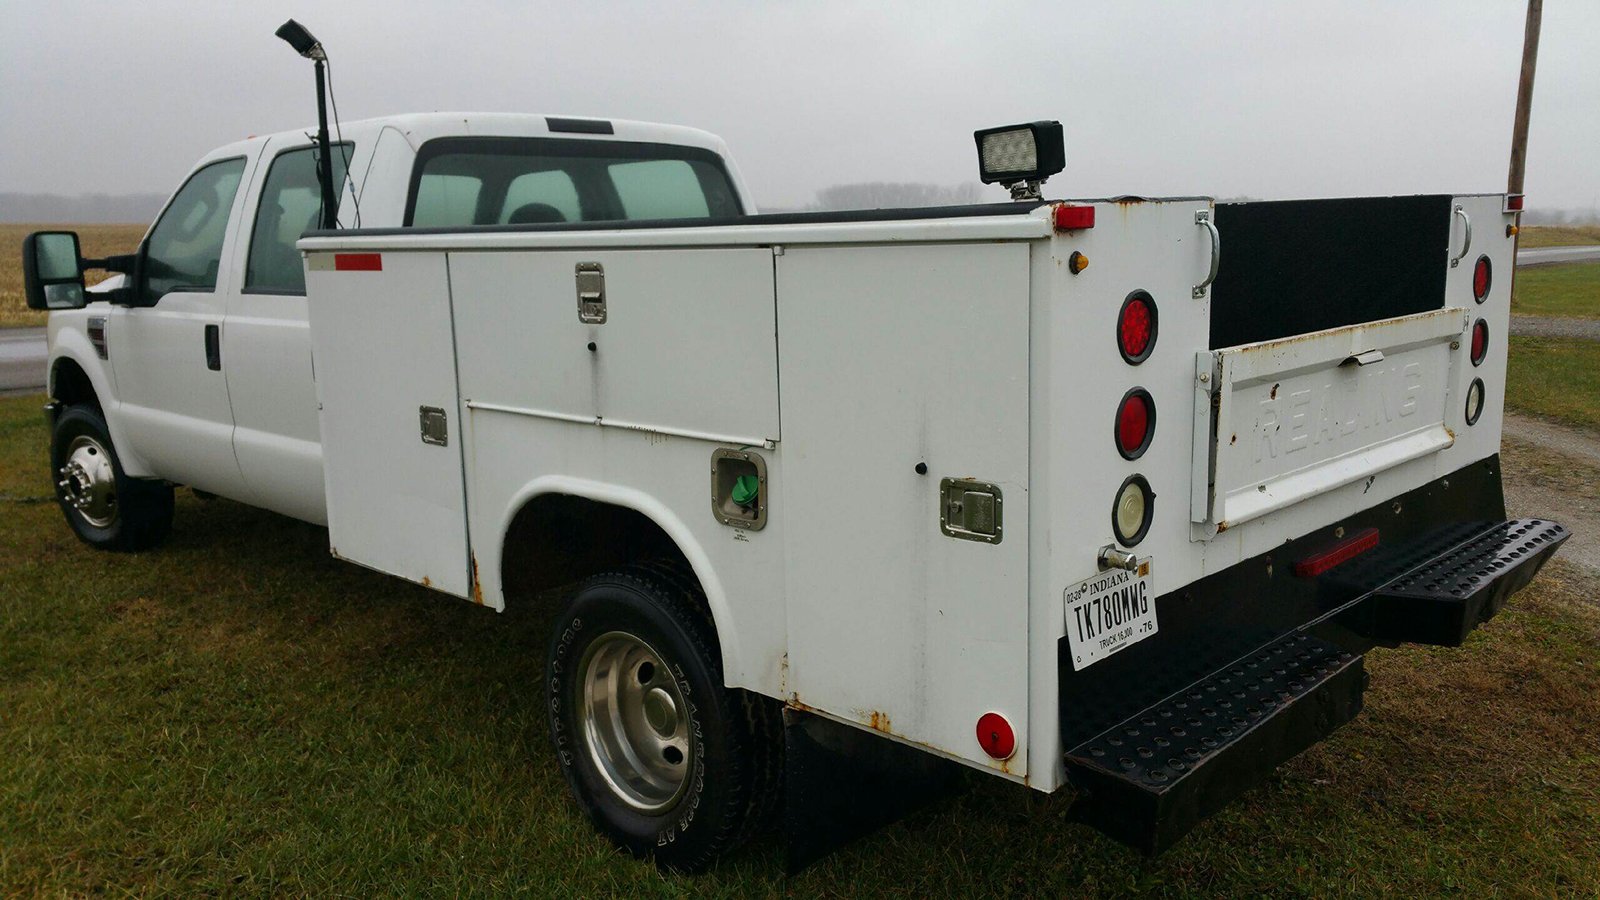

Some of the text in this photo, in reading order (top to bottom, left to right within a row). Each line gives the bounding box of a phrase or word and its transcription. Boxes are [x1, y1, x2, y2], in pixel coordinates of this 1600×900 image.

[1254, 362, 1422, 464] READING
[1090, 571, 1130, 595] INDIANA
[1074, 580, 1149, 642] TK780MWG
[1099, 633, 1118, 650] TRUCK
